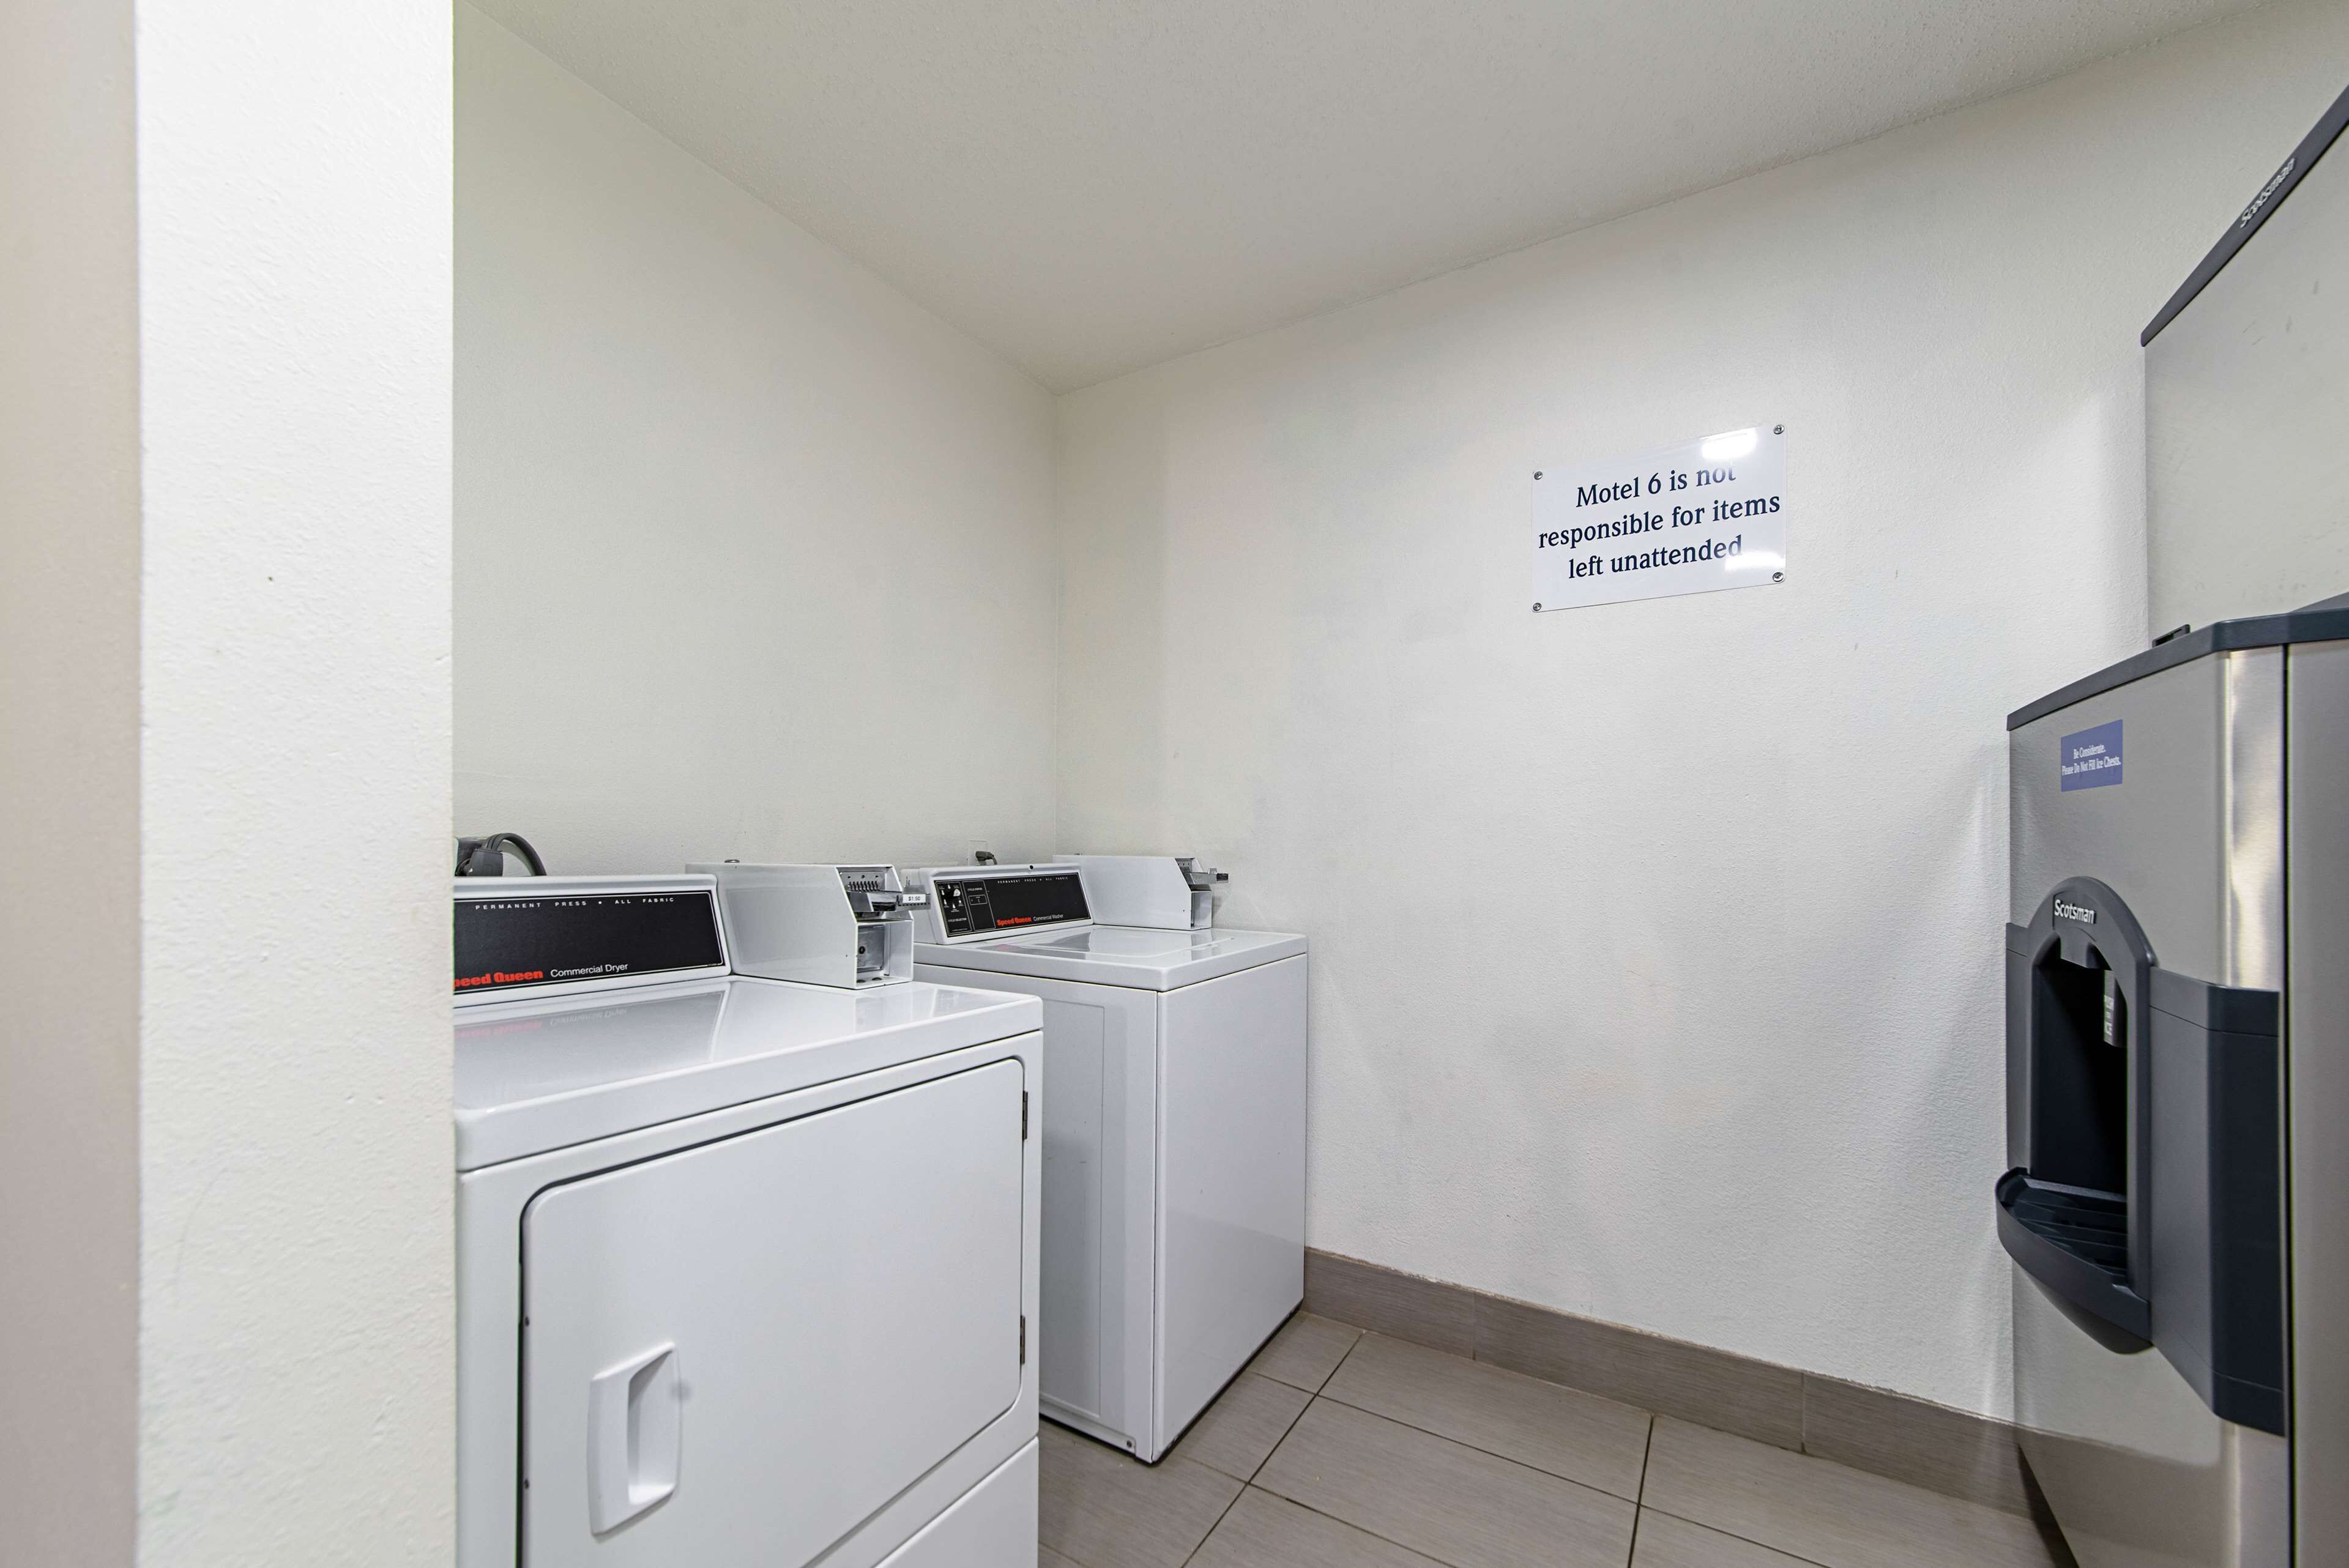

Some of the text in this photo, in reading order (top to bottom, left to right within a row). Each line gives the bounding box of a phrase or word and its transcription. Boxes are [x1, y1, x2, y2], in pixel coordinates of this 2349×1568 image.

[1576, 461, 1736, 507] Motel 6 is not
[1538, 496, 1780, 549] responsible for items
[1568, 534, 1743, 579] left unattended
[997, 918, 1014, 926] Speed
[2055, 899, 2094, 924] Scotsman
[454, 964, 628, 987] peed Queen Commercial Dryer
